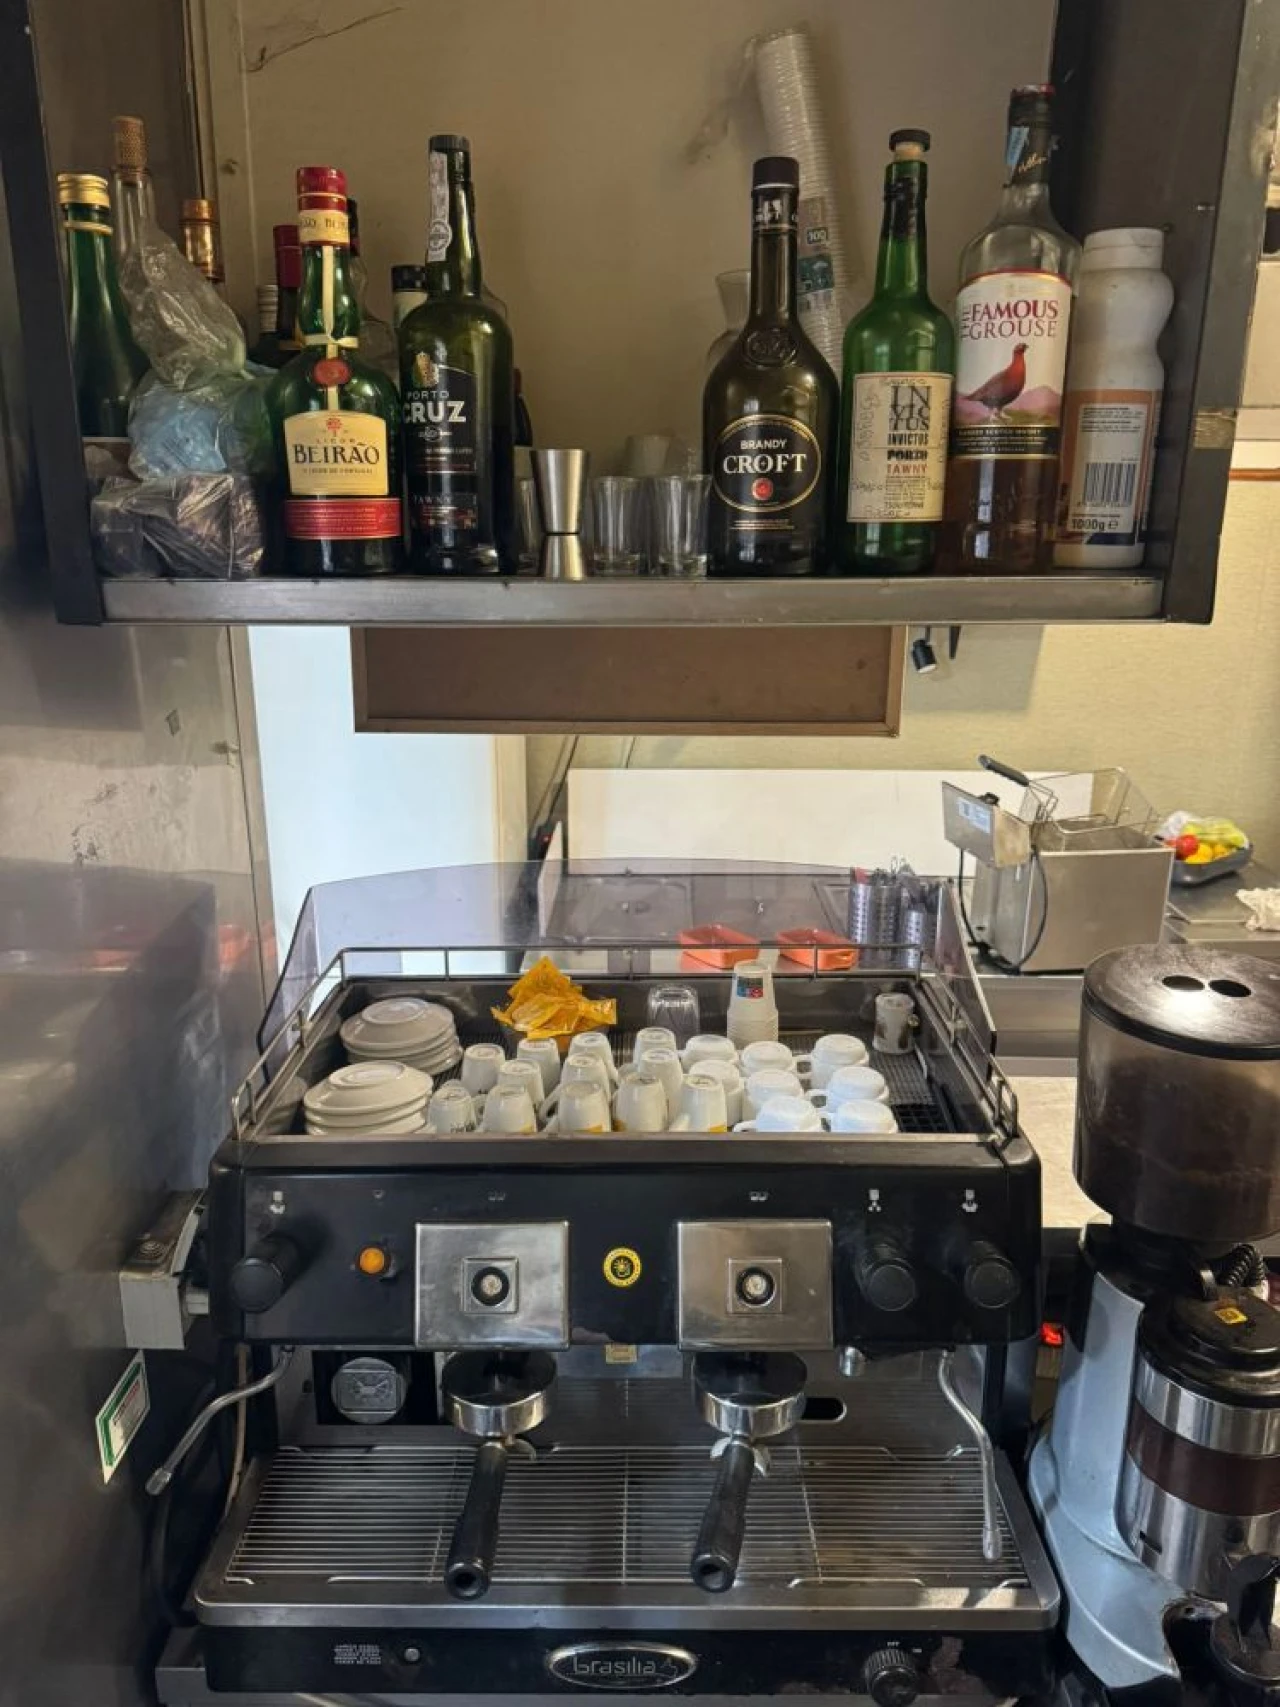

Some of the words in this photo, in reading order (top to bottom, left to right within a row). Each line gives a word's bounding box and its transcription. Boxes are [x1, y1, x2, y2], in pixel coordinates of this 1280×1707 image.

[972, 300, 1058, 321] FAMOUS
[970, 320, 1057, 340] GROUSE
[407, 390, 450, 400] PORTO
[403, 400, 467, 423] CRUZ
[293, 441, 381, 465] BEIRÃO
[740, 439, 788, 450] BRANDY
[723, 453, 807, 474] CROFT
[887, 463, 927, 475] TAWNY
[572, 1655, 656, 1675] brasilia
